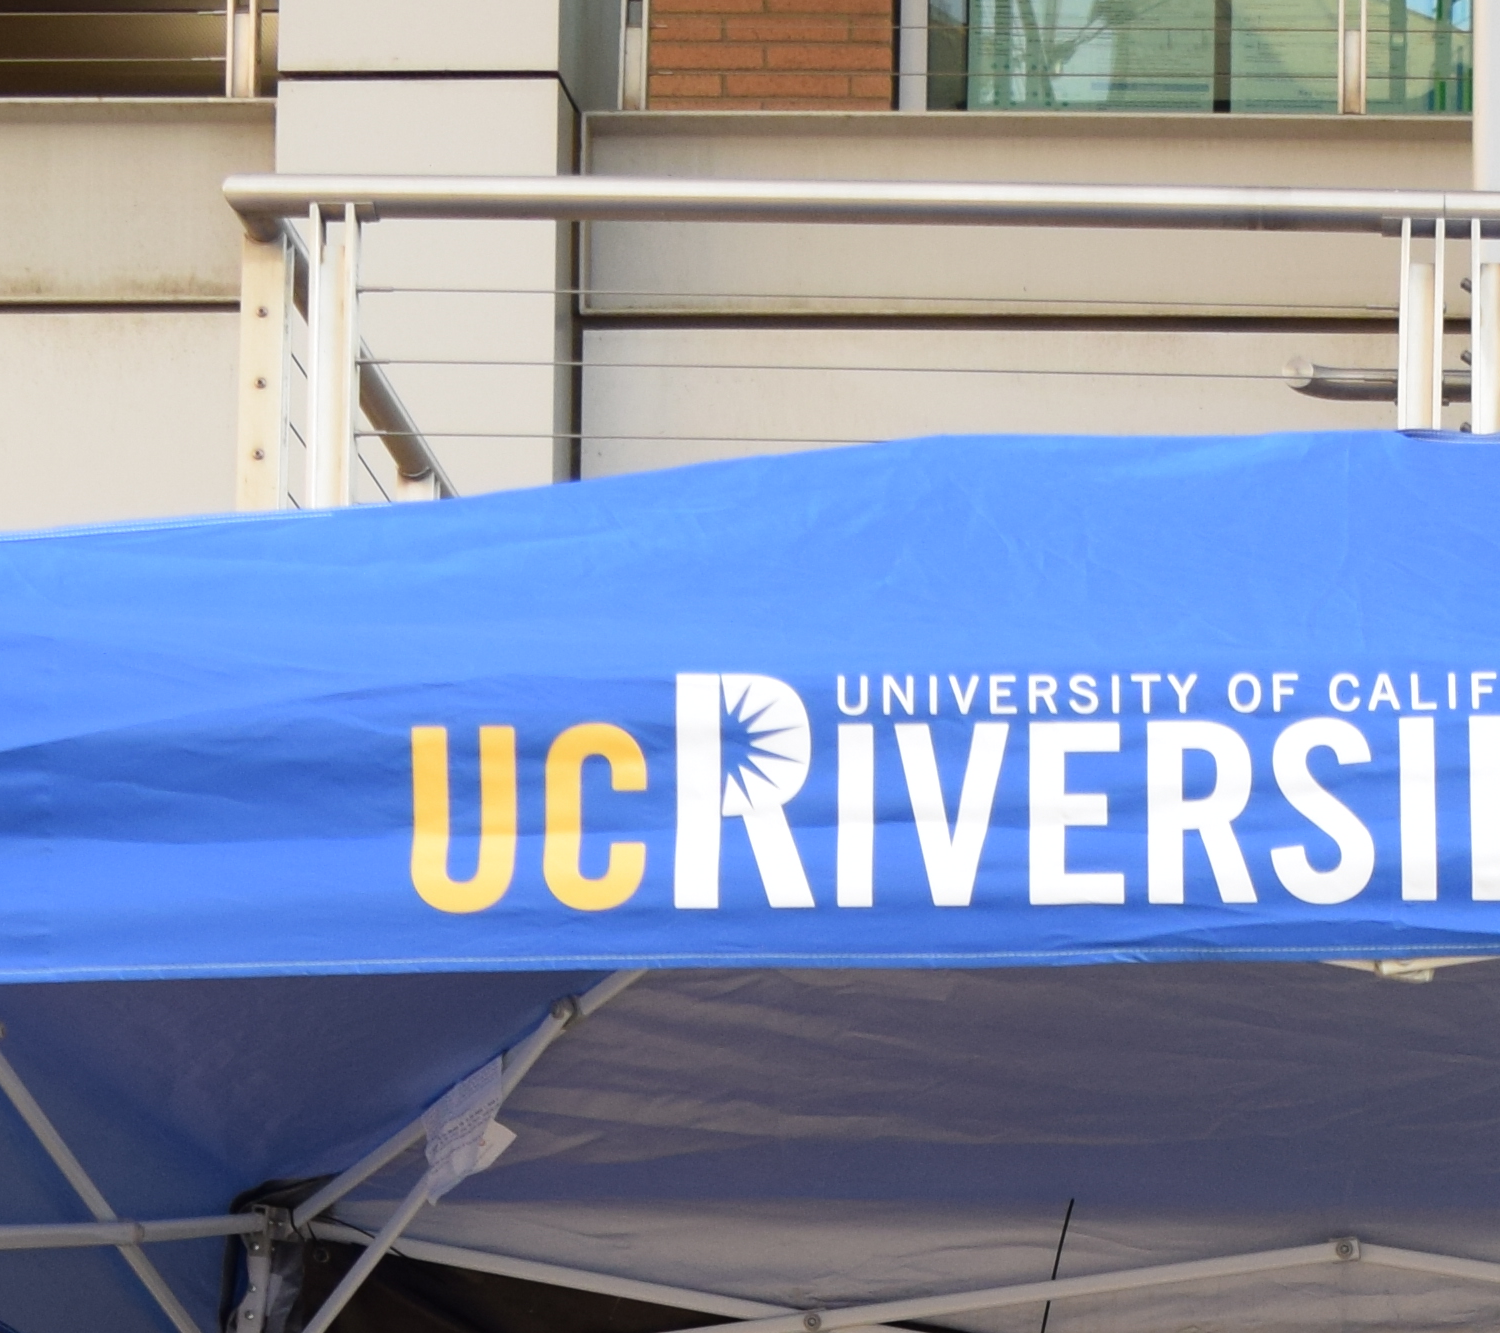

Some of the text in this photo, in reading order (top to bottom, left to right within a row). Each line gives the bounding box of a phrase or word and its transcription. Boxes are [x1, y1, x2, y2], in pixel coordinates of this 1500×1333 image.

[836, 673, 1198, 716] UNIVERSITY
[1227, 672, 1299, 713] OF
[410, 721, 648, 914] UC
